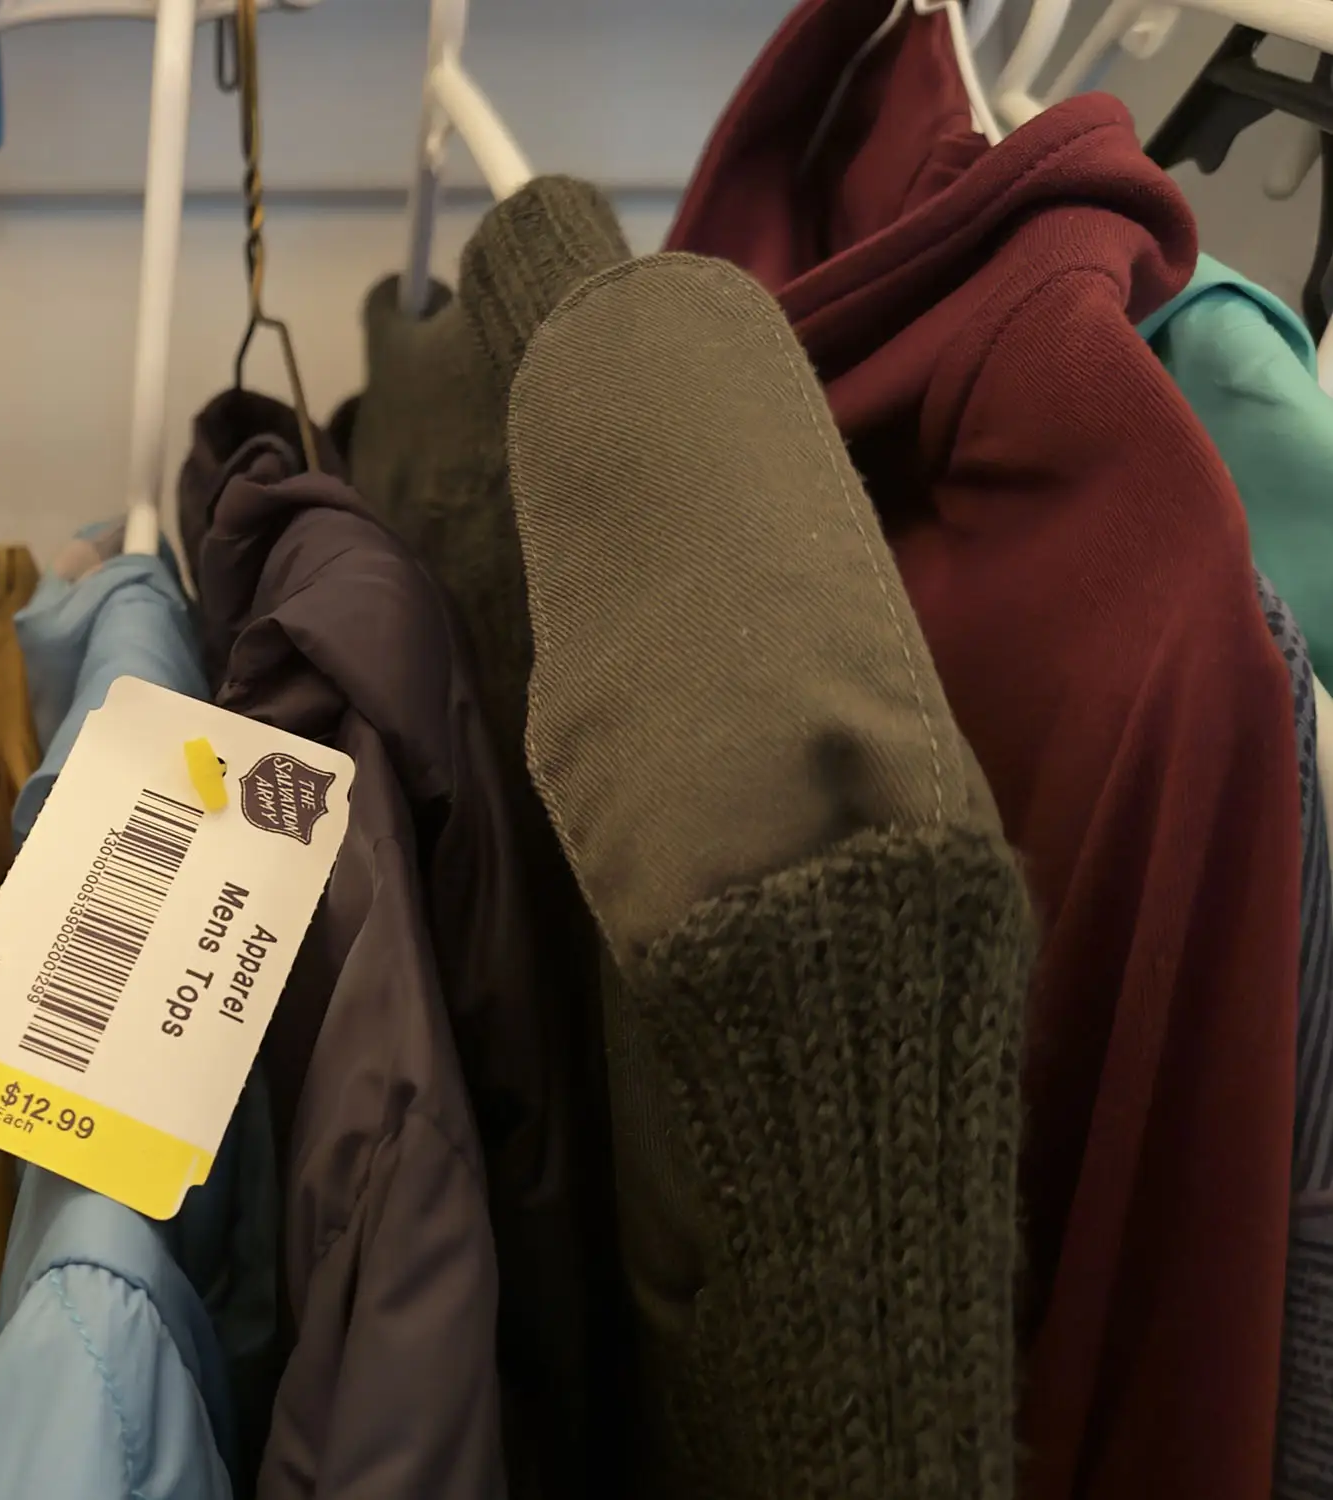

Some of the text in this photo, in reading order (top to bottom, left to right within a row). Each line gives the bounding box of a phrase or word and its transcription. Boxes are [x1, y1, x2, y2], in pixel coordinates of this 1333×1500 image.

[254, 775, 279, 824] ARMY
[273, 758, 302, 835] SALVATION
[298, 780, 316, 810] THE
[27, 827, 122, 1005] X30101005139002001299
[161, 881, 250, 1037] Mens Tops
[219, 924, 278, 1024] Apparel
[1, 1081, 95, 1139] $12.99
